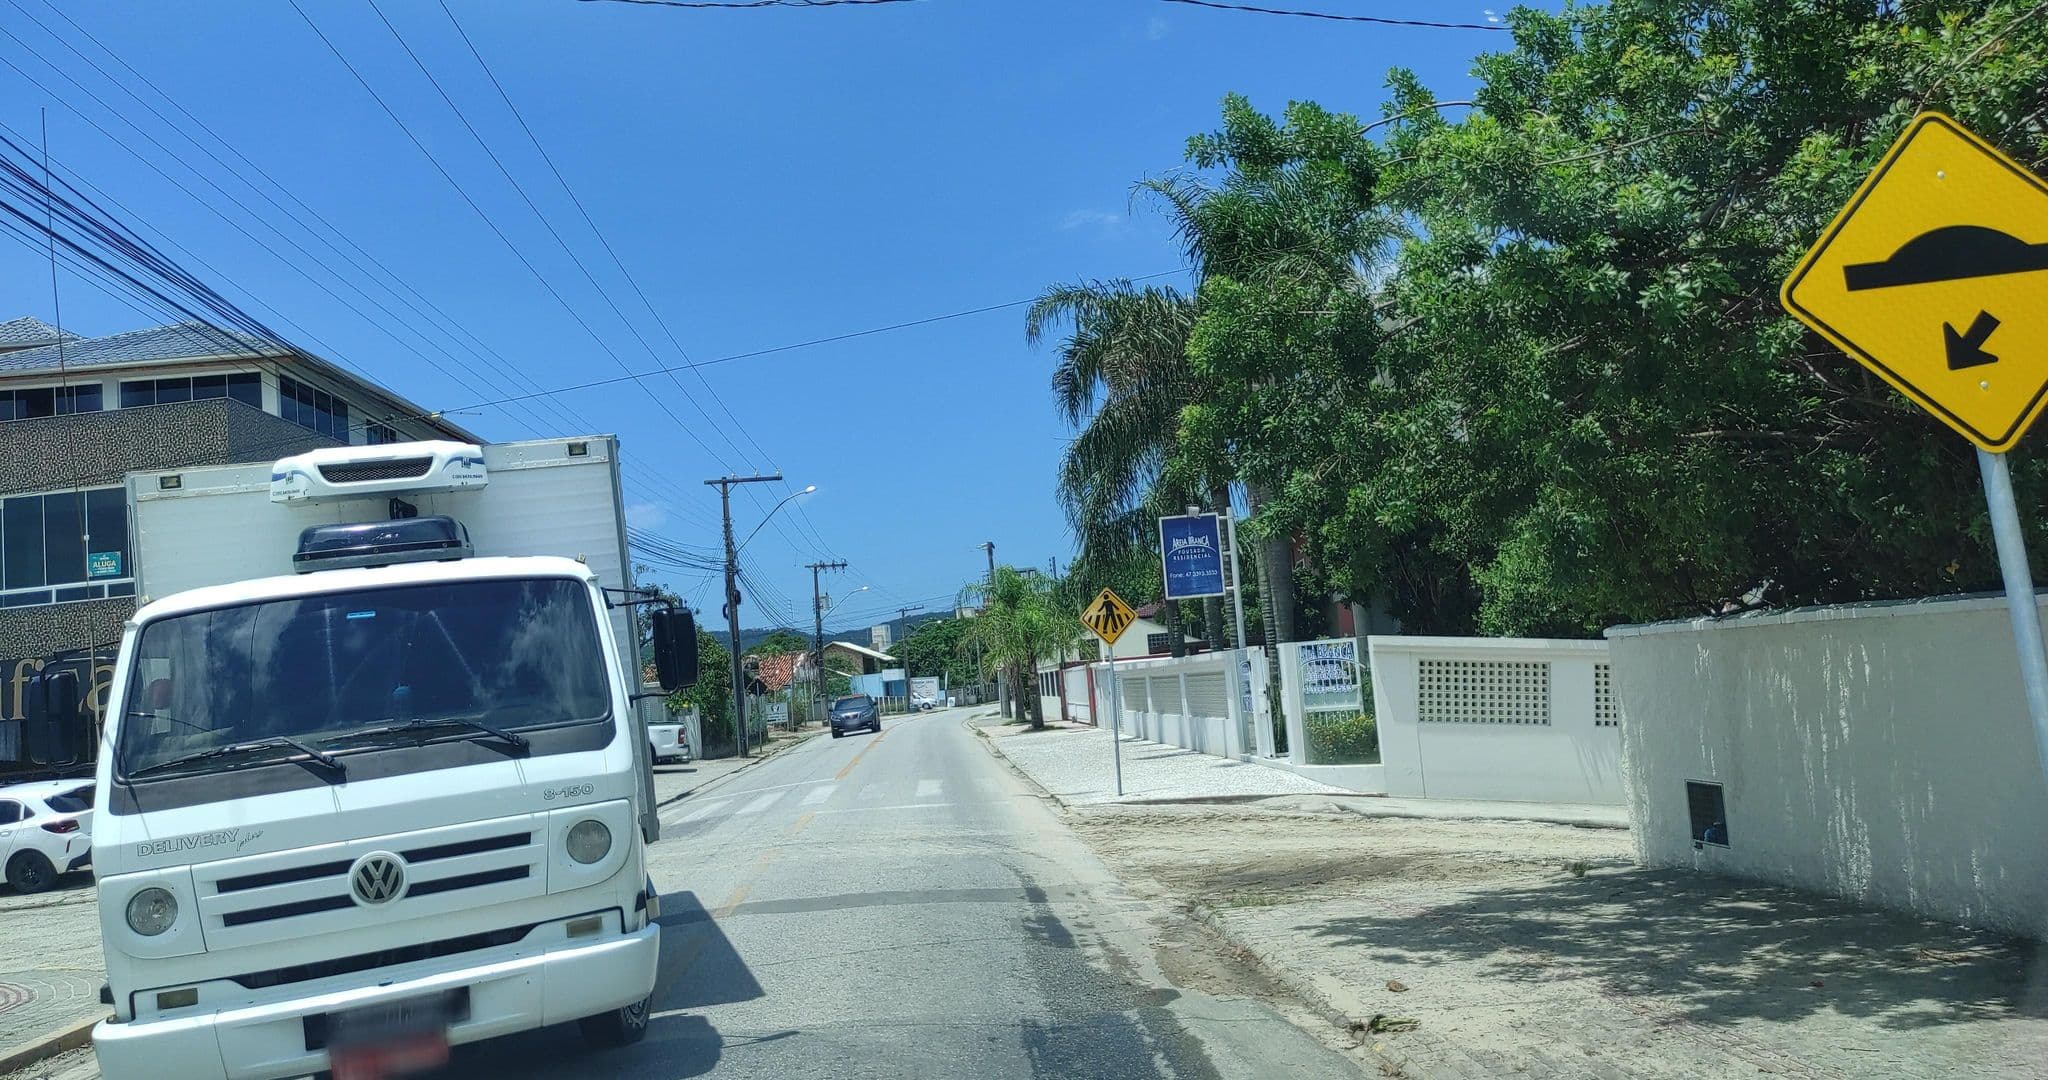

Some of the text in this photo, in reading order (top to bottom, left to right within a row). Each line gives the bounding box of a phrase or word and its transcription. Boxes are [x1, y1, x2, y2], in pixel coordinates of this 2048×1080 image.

[1188, 534, 1210, 547] BRANCA
[93, 560, 117, 568] ALUGA
[543, 782, 595, 801] 8-150
[136, 829, 240, 857] DELIVERY
